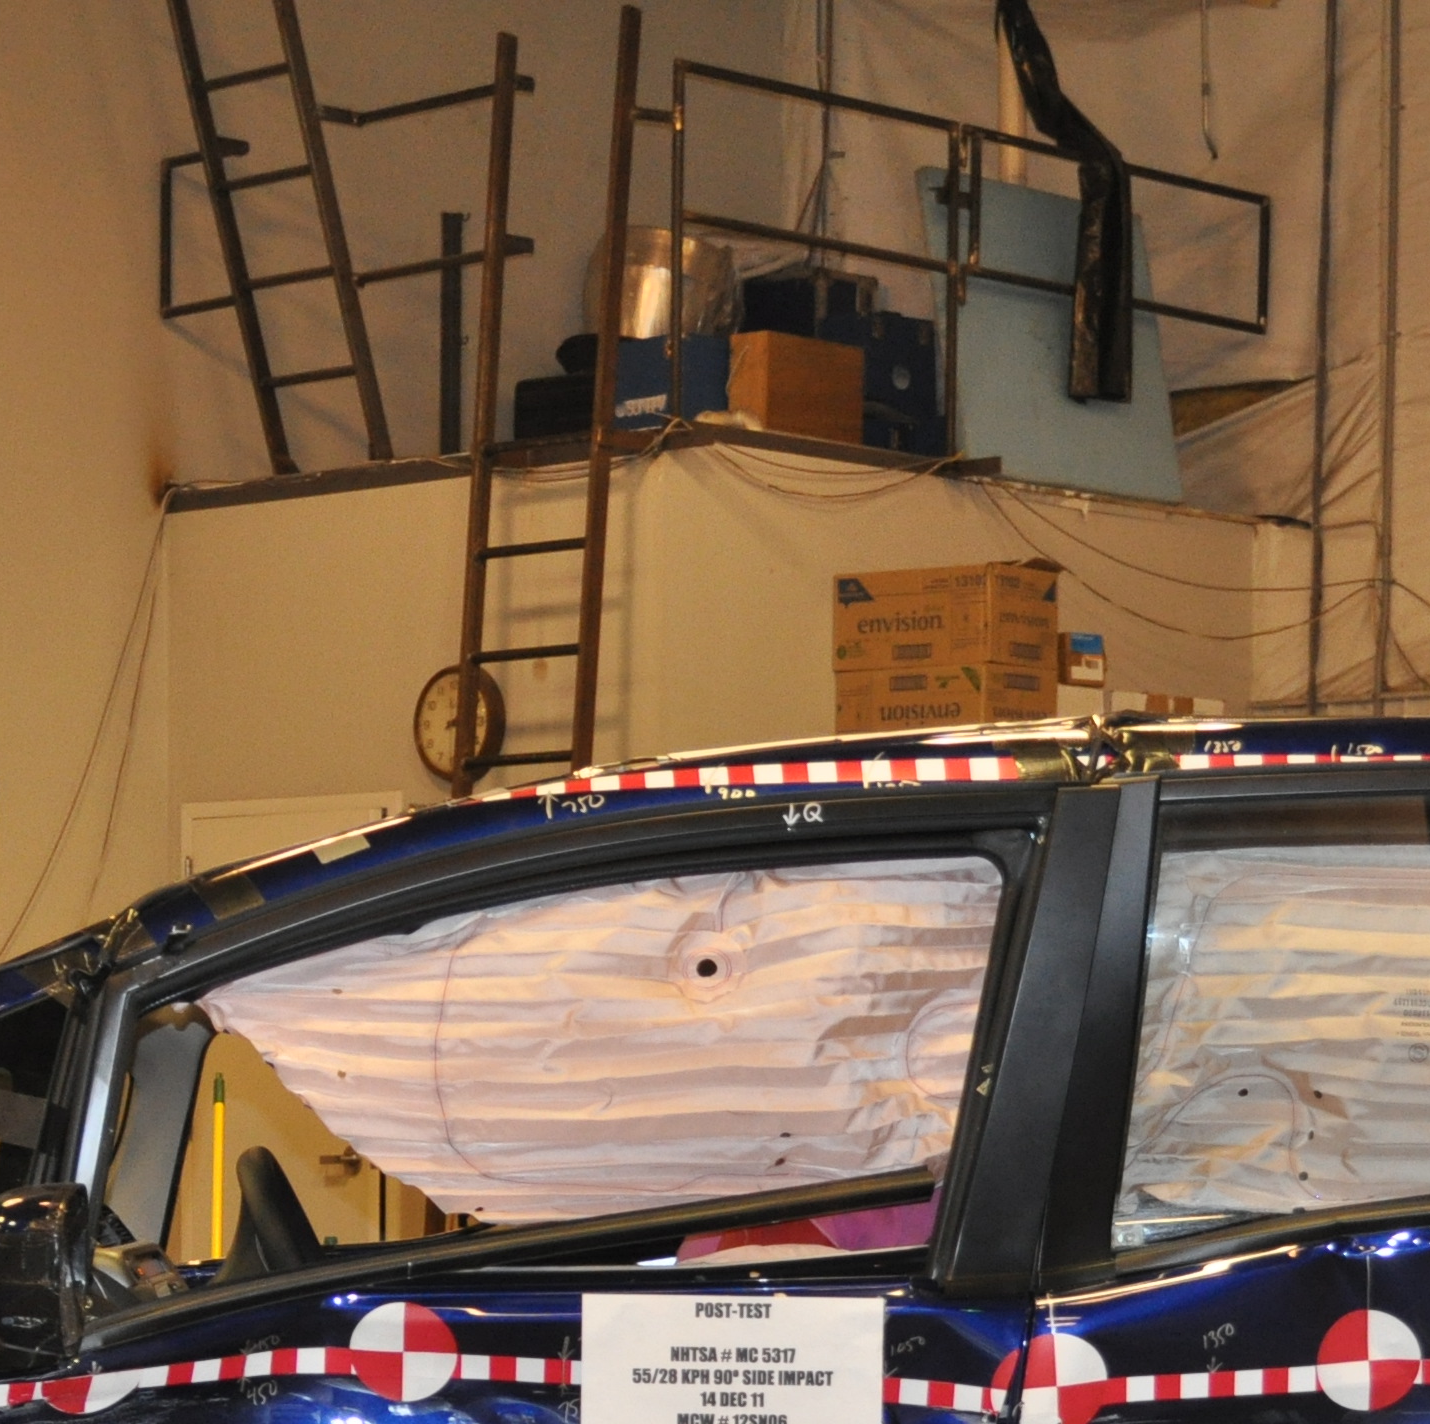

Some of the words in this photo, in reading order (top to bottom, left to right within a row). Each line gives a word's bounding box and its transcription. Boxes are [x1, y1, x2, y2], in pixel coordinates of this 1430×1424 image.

[857, 612, 945, 637] envision
[998, 610, 1053, 630] envision
[802, 802, 824, 823] Q
[694, 1302, 772, 1319] POST-TEST
[670, 1346, 718, 1362] NHTSA
[720, 1348, 732, 1362] #
[735, 1347, 759, 1363] MC
[761, 1348, 796, 1364] 5317
[632, 1368, 678, 1385] 55/28
[681, 1369, 710, 1385] KPH
[742, 1370, 775, 1386] SIDE
[777, 1370, 833, 1387] IMPACT
[700, 1392, 717, 1407] 14
[720, 1392, 747, 1408] DEC
[750, 1392, 765, 1408] 11
[557, 1400, 581, 1424] 75
